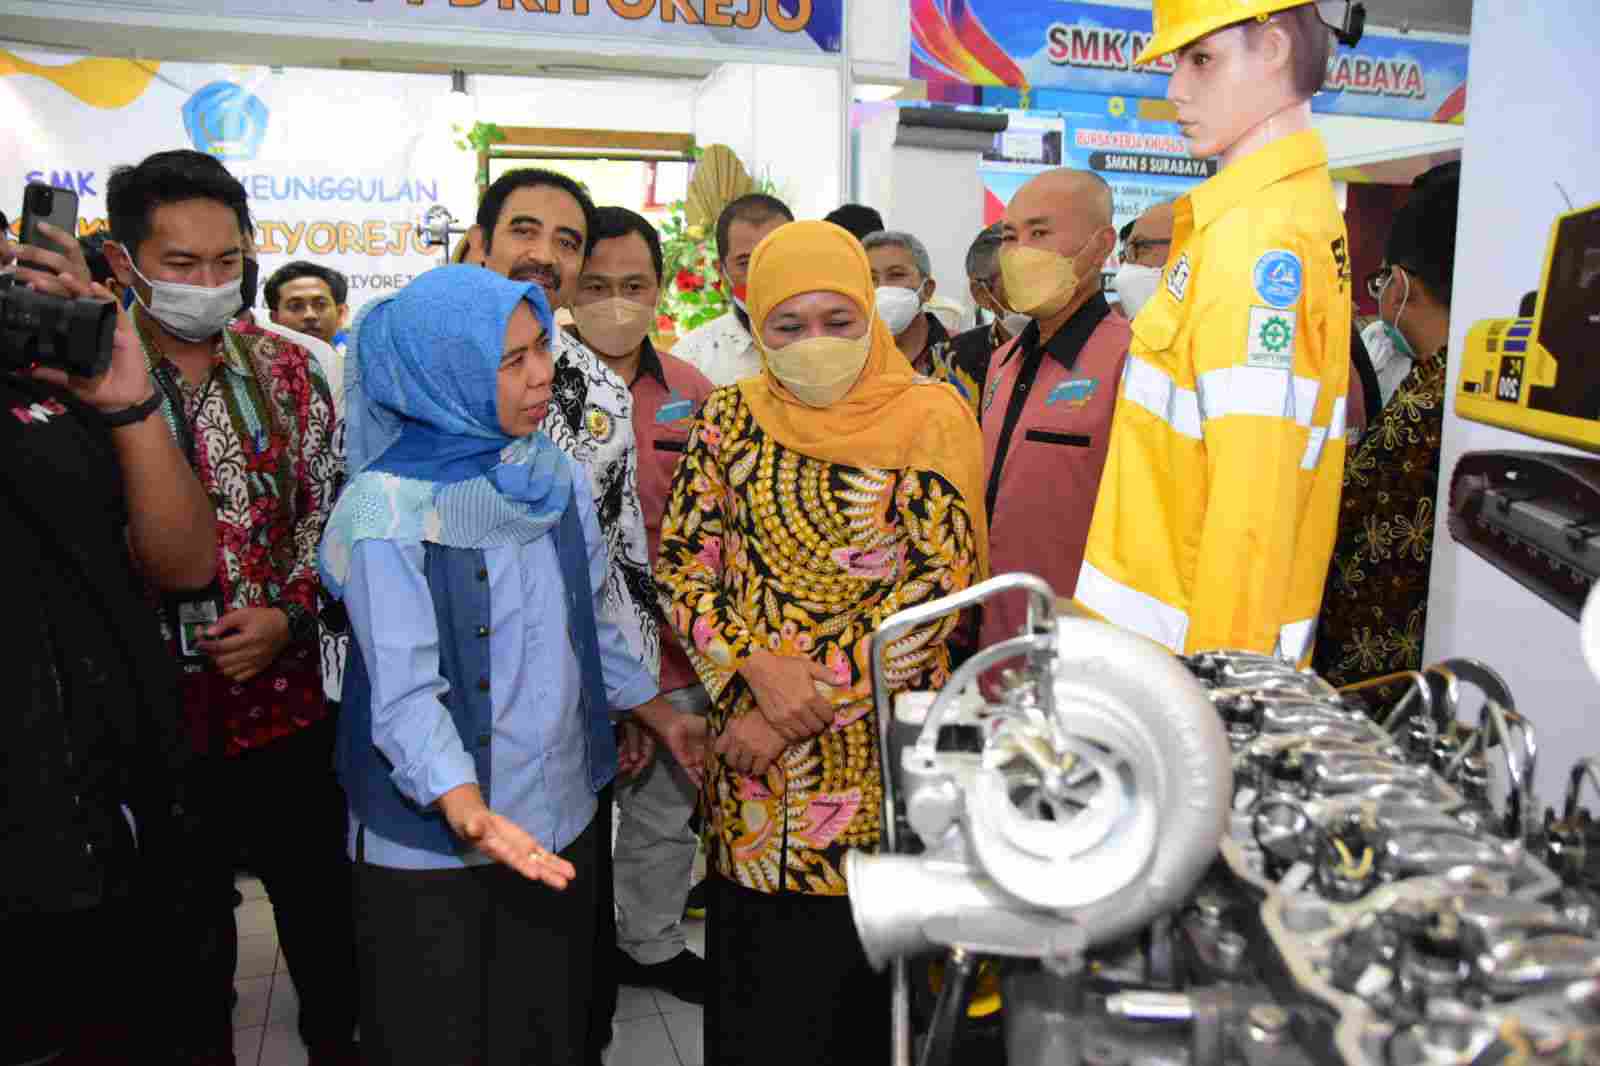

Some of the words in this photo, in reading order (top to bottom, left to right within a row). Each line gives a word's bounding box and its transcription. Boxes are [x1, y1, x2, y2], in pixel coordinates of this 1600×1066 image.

[1049, 26, 1125, 65] SMK
[1105, 154, 1138, 171] SMKN
[1150, 157, 1208, 176] SURABAYA
